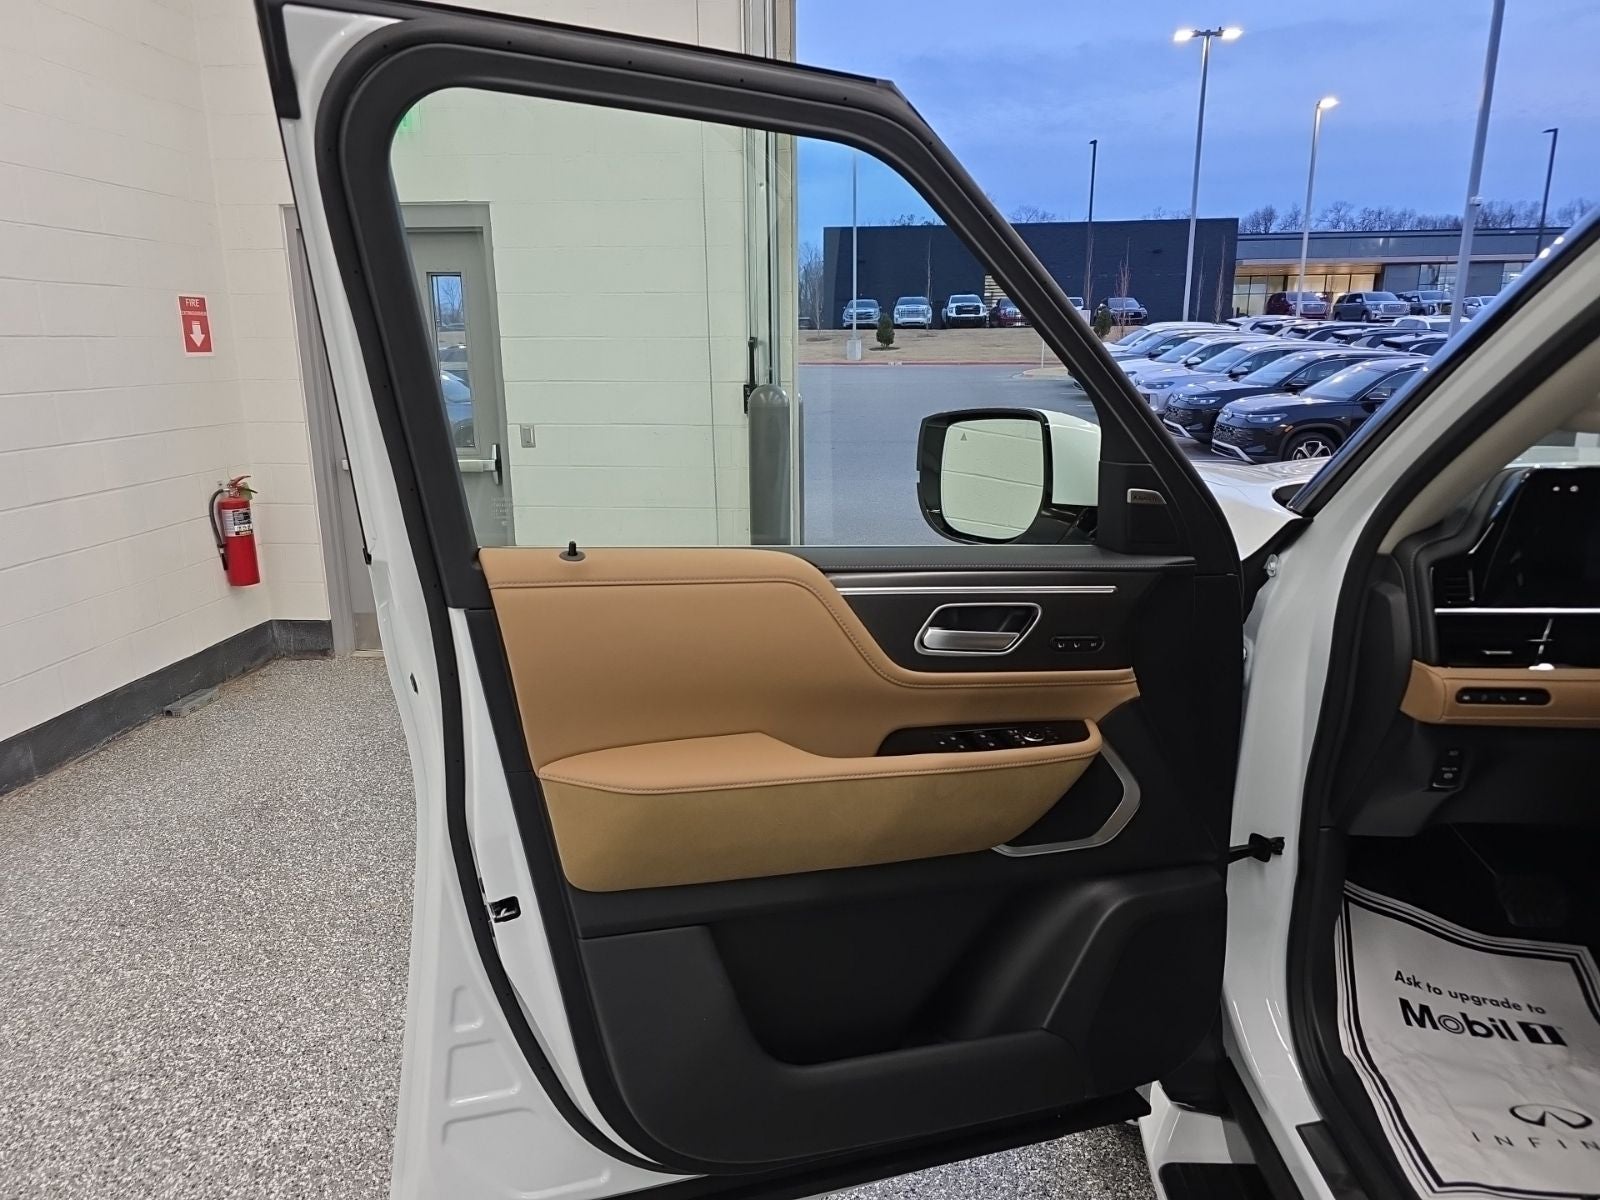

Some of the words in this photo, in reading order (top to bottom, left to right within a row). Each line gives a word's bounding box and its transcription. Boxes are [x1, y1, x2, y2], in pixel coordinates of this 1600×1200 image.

[185, 298, 201, 308] FIRE
[1394, 970, 1422, 990] Ask
[1426, 982, 1443, 995] to
[1447, 990, 1523, 1011] upgrade
[1526, 1001, 1546, 1015] to
[1398, 997, 1520, 1042] Mobil
